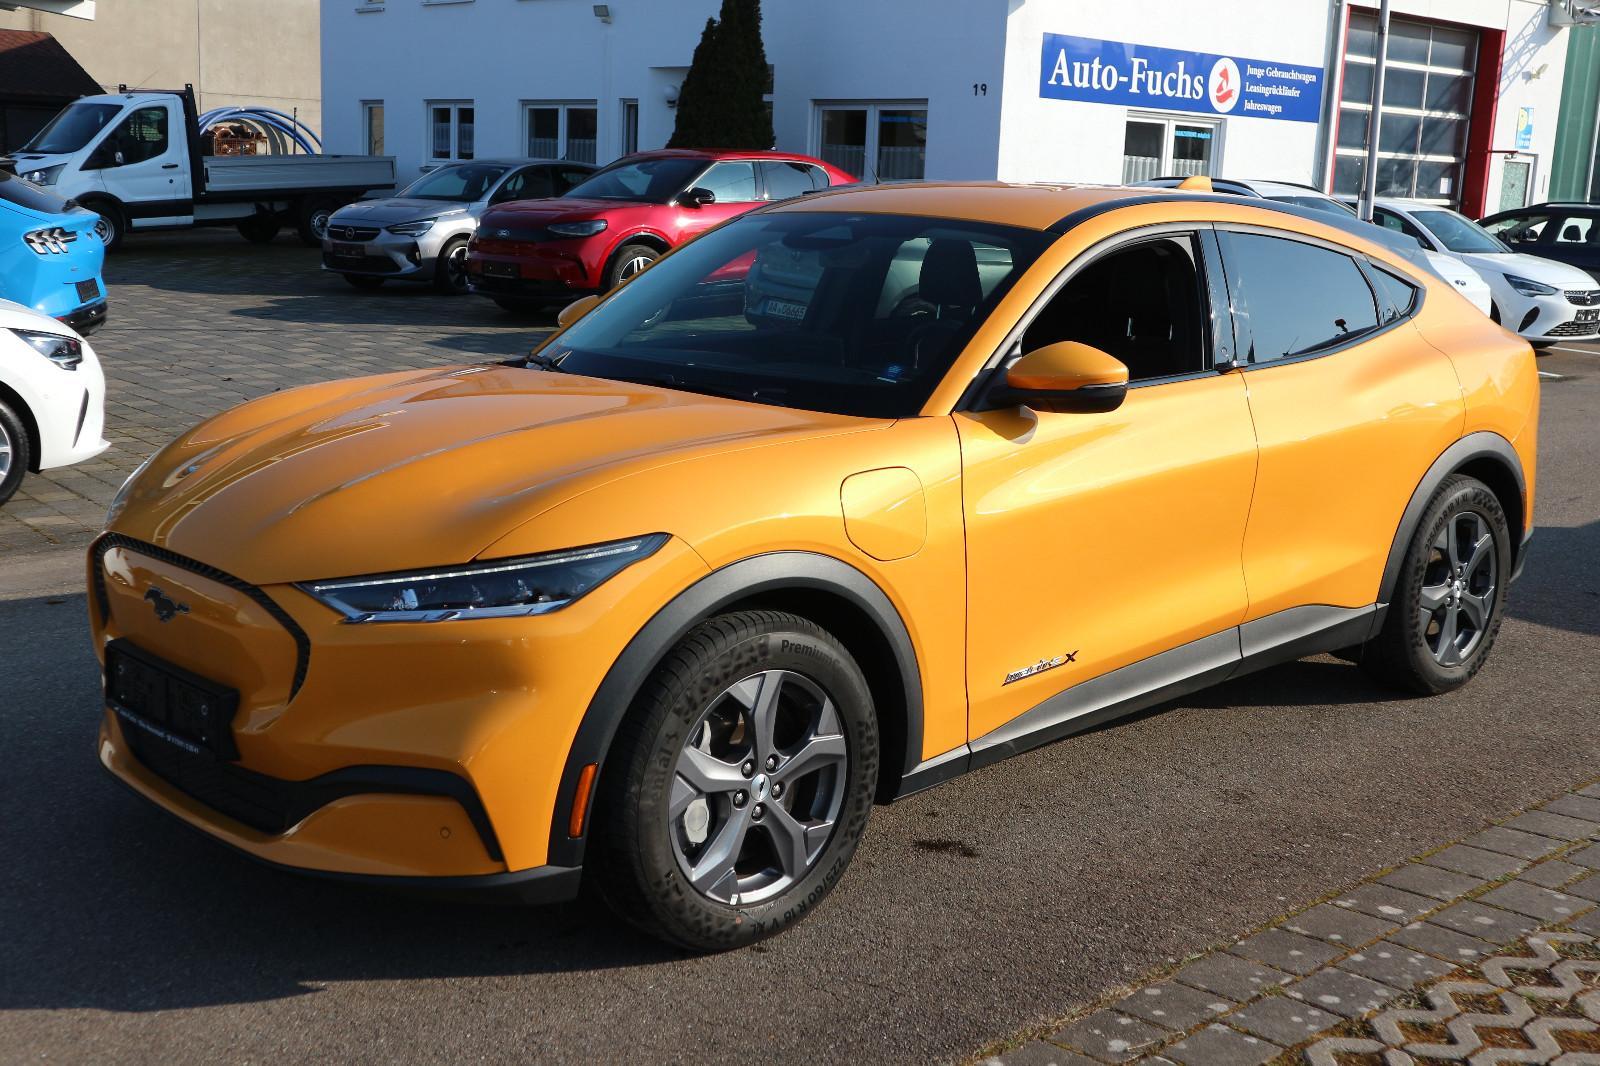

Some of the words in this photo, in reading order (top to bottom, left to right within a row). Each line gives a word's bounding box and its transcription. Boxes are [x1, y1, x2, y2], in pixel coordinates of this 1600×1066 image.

[1048, 48, 1204, 100] Auto-Fuchs
[1246, 64, 1265, 78] Junge
[1266, 66, 1317, 84] Gebrauchtwagen
[972, 83, 988, 96] 19
[1245, 81, 1301, 98] Leasingrückläufer
[1243, 99, 1282, 115] Jahreswagen
[807, 856, 845, 905] 225/60
[784, 908, 797, 923] 18
